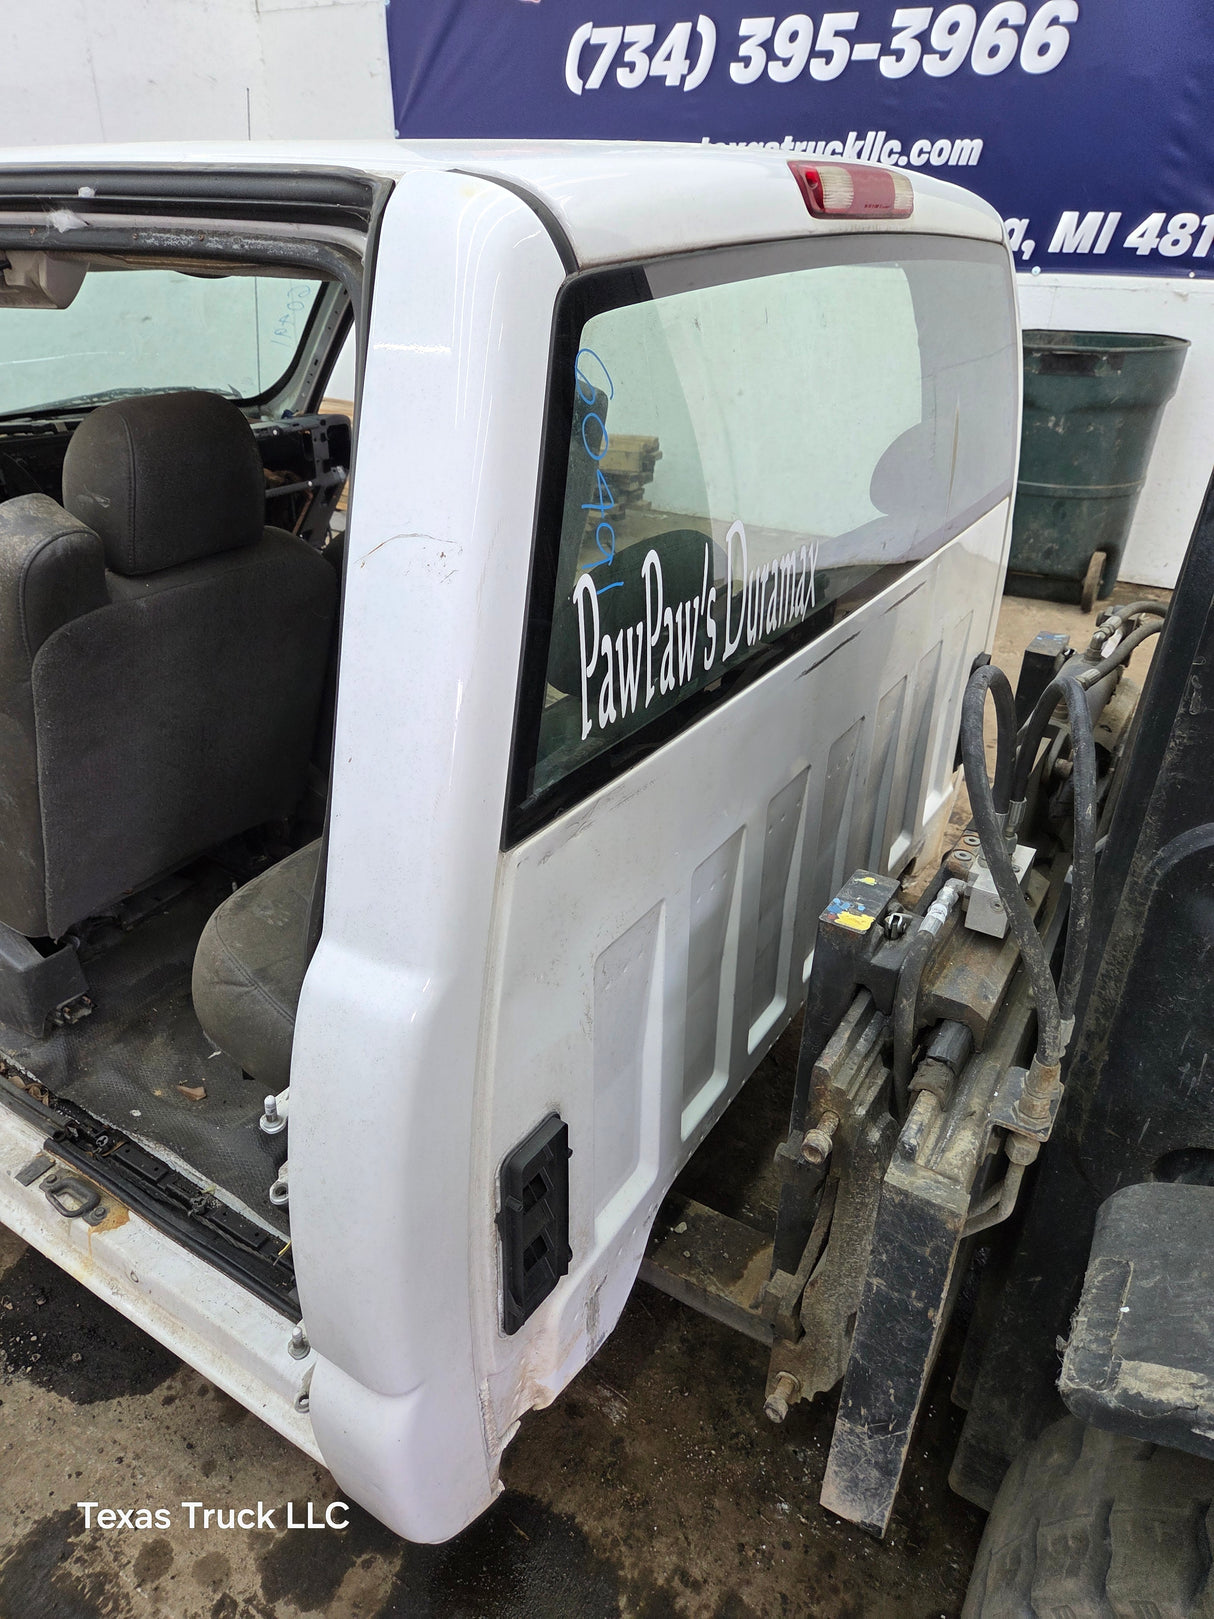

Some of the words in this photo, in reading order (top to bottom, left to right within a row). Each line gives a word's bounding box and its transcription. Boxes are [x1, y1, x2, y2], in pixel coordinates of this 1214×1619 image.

[565, 14, 717, 96] (734)
[729, 0, 1080, 85] 395-3966
[1048, 211, 1122, 254] MI
[572, 541, 717, 741] PawPaw's
[721, 519, 820, 663] Duramax
